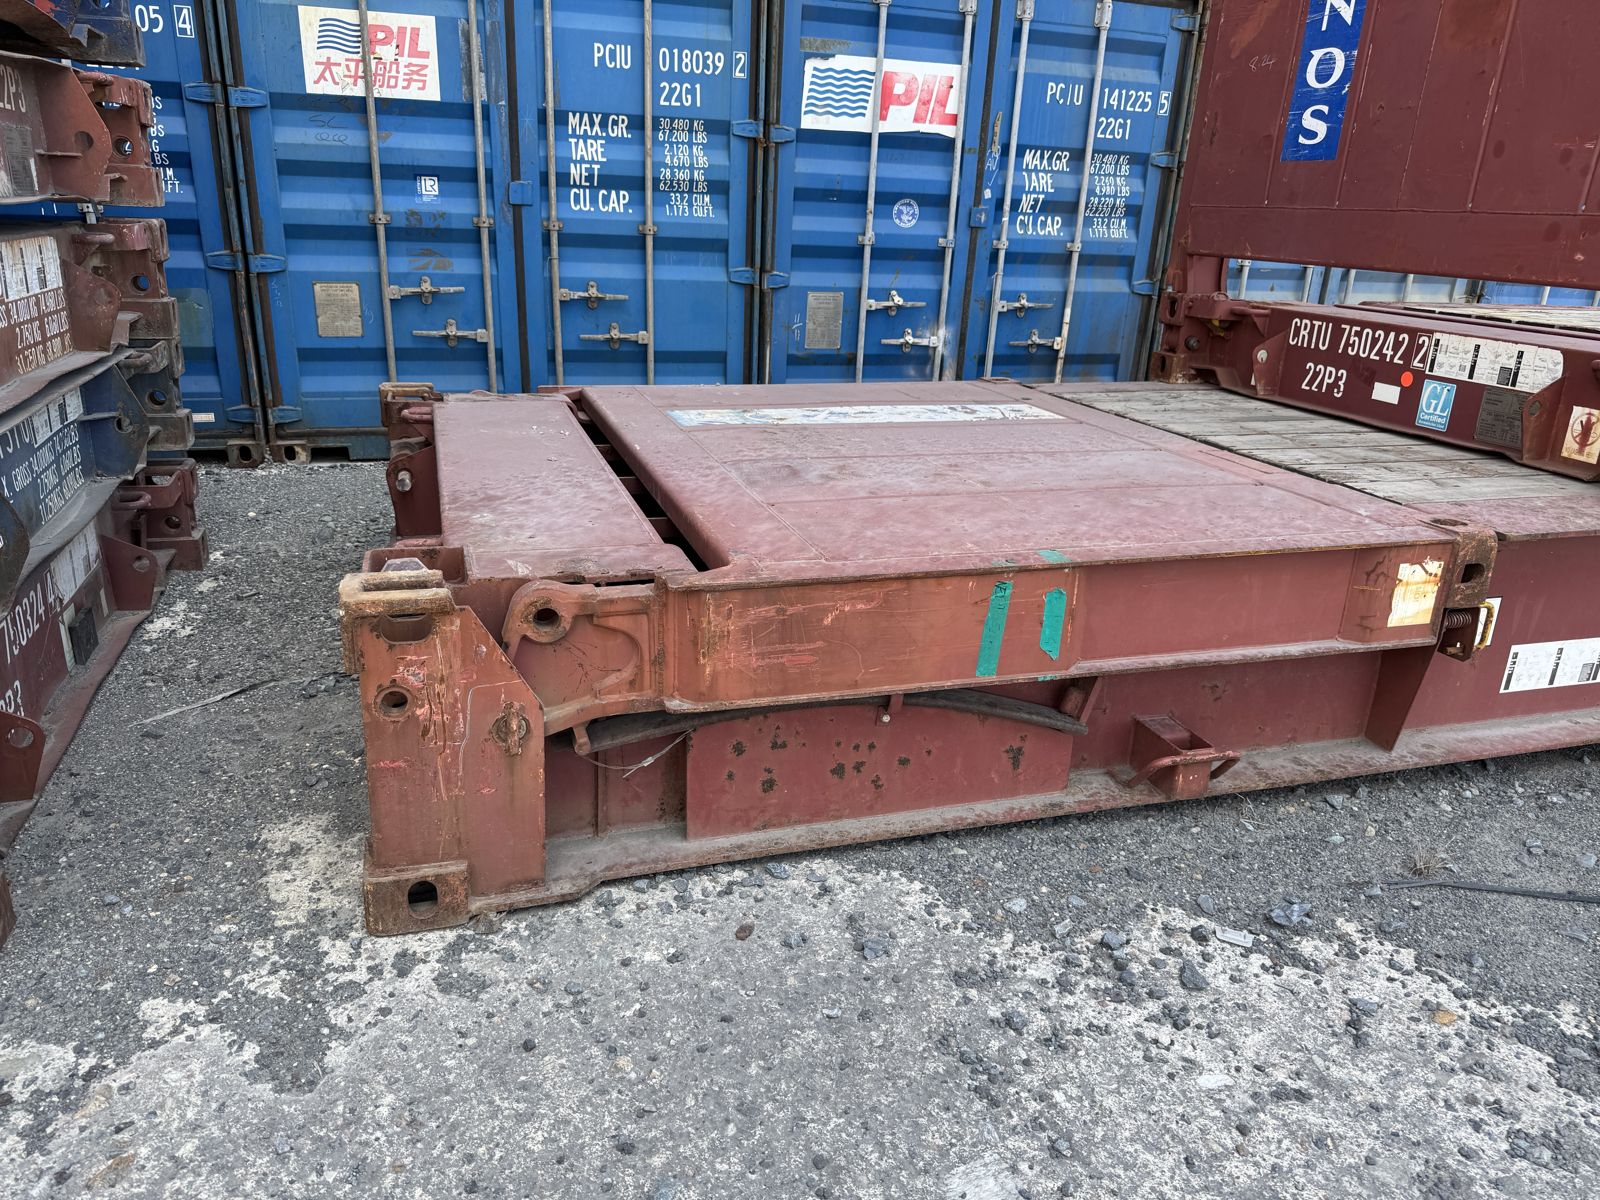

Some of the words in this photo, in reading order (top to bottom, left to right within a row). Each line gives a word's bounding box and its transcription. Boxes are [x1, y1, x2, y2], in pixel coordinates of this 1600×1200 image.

[367, 24, 430, 59] PIL
[594, 42, 631, 69] PCIU
[658, 47, 725, 75] 018039
[734, 52, 746, 77] 2
[313, 56, 430, 91] 太平船务
[659, 81, 701, 107] 22G1
[880, 71, 958, 126] PIL
[1046, 82, 1083, 105] PCIU
[1103, 88, 1152, 112] 141225
[1158, 92, 1170, 114] 5
[659, 118, 689, 130] 30.480
[693, 120, 704, 131] KG
[1097, 117, 1131, 140] 22G1
[658, 130, 688, 142] 67.200
[693, 132, 707, 143] LBS
[569, 138, 607, 161] TARE
[664, 144, 689, 156] 2.120
[692, 145, 704, 157] KG
[665, 156, 690, 167] 4.670
[693, 157, 708, 168] LBS
[1092, 153, 1117, 164] 30.480
[1119, 155, 1129, 165] KG
[570, 163, 600, 186] NET
[660, 168, 690, 180] 28.360
[693, 170, 705, 181] KG
[1090, 164, 1115, 174] 67.200
[1117, 165, 1130, 175] LBS
[423, 178, 438, 193] LR
[659, 181, 689, 192] 62.530
[693, 182, 708, 192] LBS
[1023, 171, 1054, 192] TARE
[1116, 177, 1126, 186] KG
[1117, 187, 1130, 197] LBS
[1018, 194, 1045, 213] NET
[1088, 197, 1114, 208] 28.220
[1116, 198, 1126, 208] KG
[666, 205, 689, 216] 1.173
[1085, 207, 1110, 217] 62.220
[1112, 208, 1126, 217] LBS
[1089, 229, 1108, 238] 1.173
[1289, 318, 1333, 351] CRTU
[1338, 324, 1409, 364] 750242
[1411, 334, 1430, 369] 2
[1301, 362, 1347, 398] 22P3
[1422, 383, 1449, 416] GL
[1420, 412, 1447, 424] Certified
[12, 461, 32, 492] GROSS
